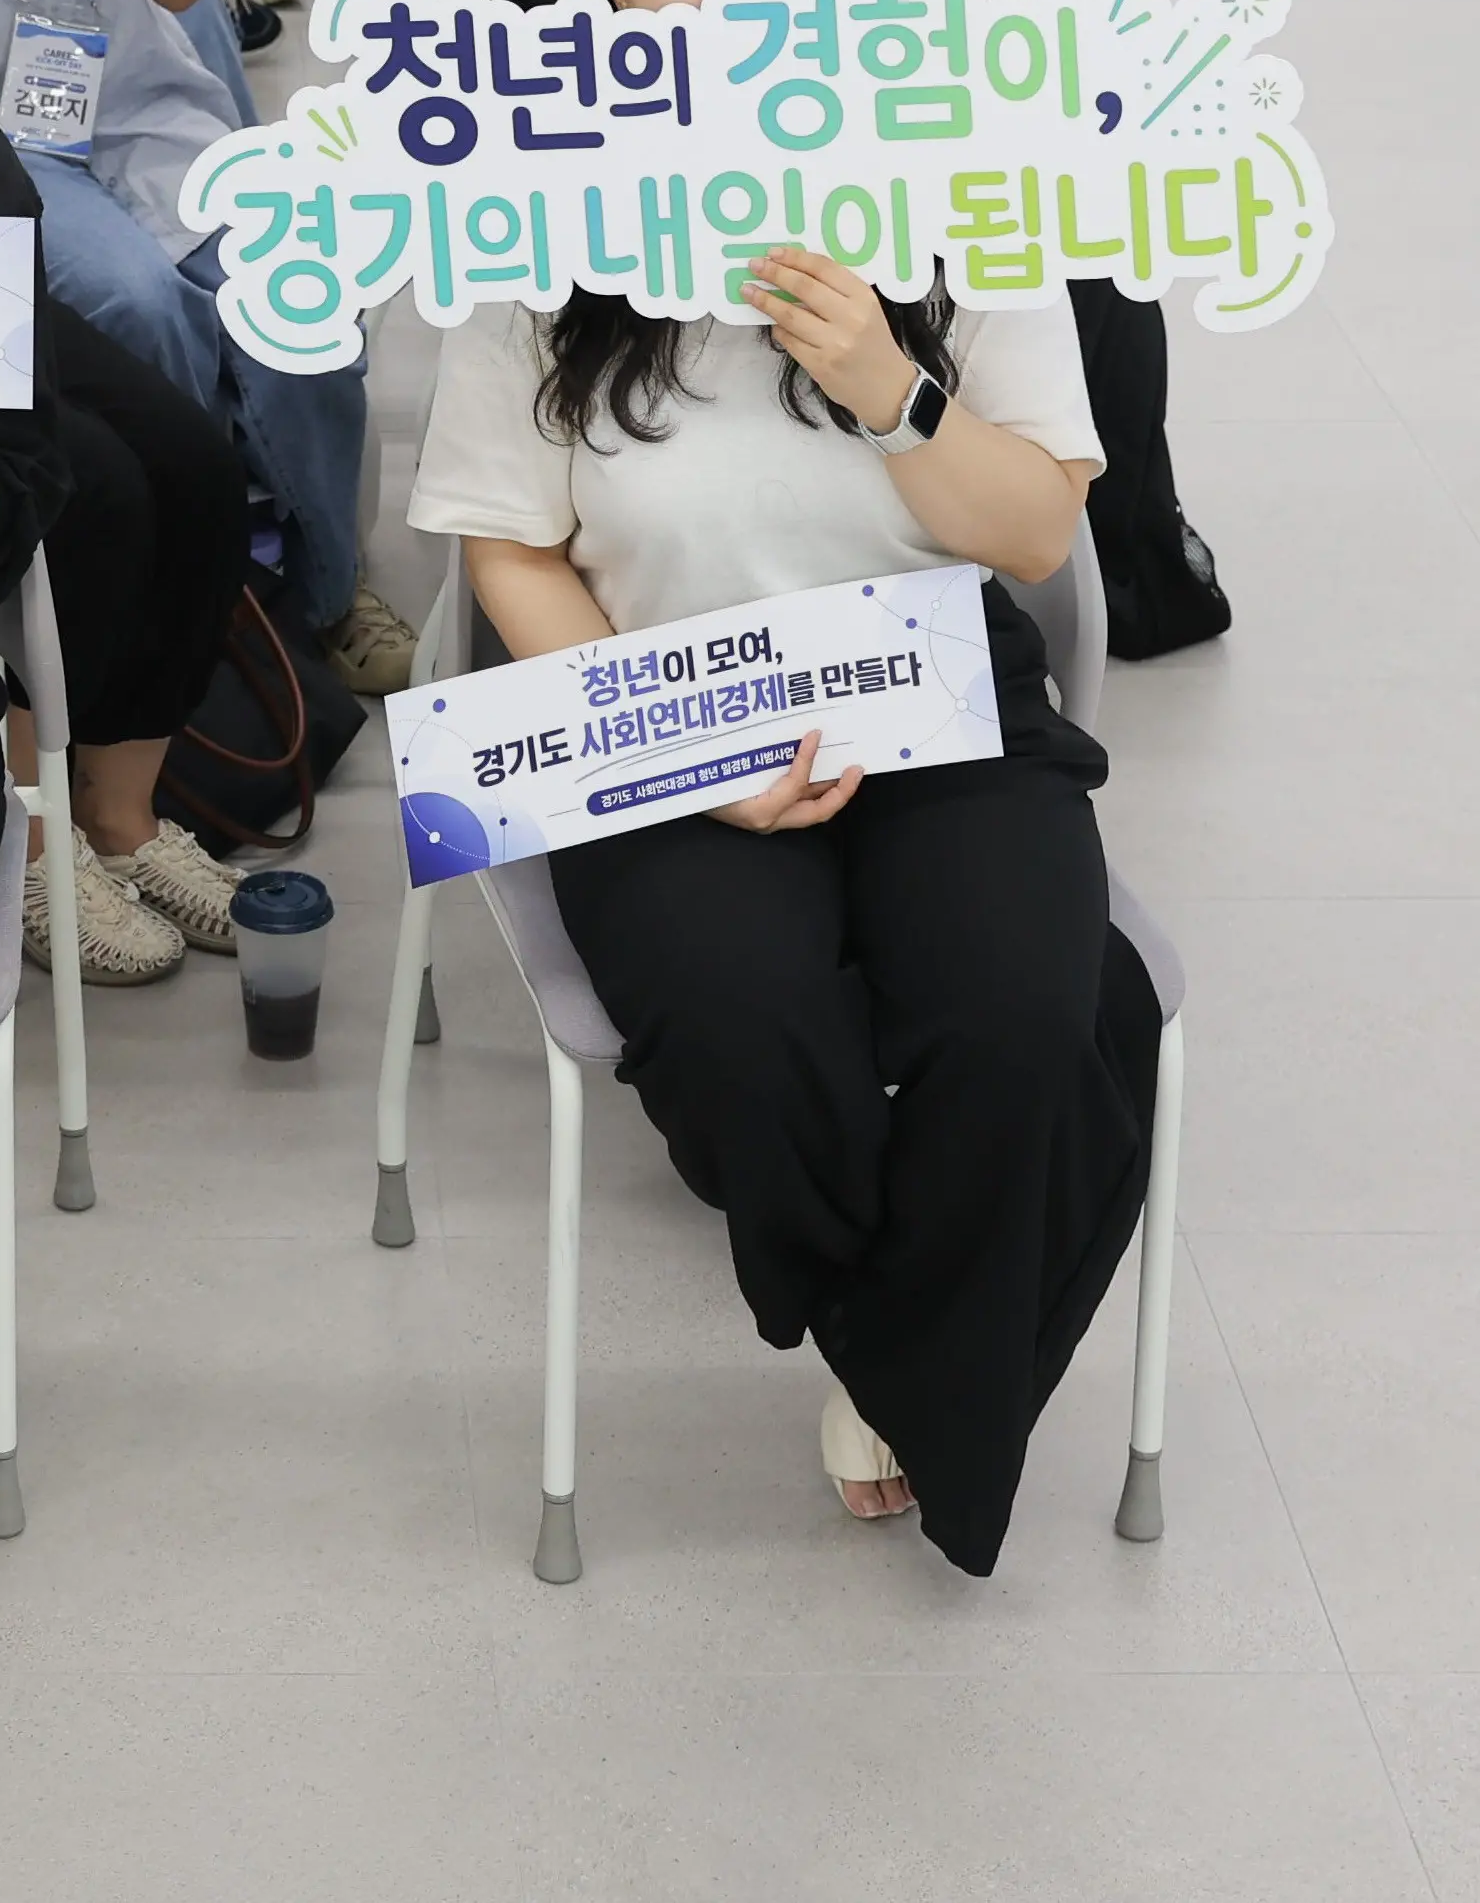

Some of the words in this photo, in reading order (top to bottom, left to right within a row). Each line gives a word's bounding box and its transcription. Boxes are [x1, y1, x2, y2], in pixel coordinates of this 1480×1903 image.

[362, 2, 692, 166] 청년의
[234, 180, 551, 325] 경기의
[584, 168, 912, 304] 내일이
[946, 157, 1274, 290] 됩니다
[473, 728, 572, 787] 경기도
[580, 668, 814, 755] 사회연대경제를
[820, 652, 921, 698] 만들다
[582, 645, 696, 707] 청년이
[706, 627, 783, 675] 모여,
[602, 789, 633, 808] 경기도
[636, 772, 696, 798] 사회연대경제
[698, 766, 719, 782] 청년
[721, 757, 751, 775] 일경험
[754, 746, 794, 766] 시범사업
